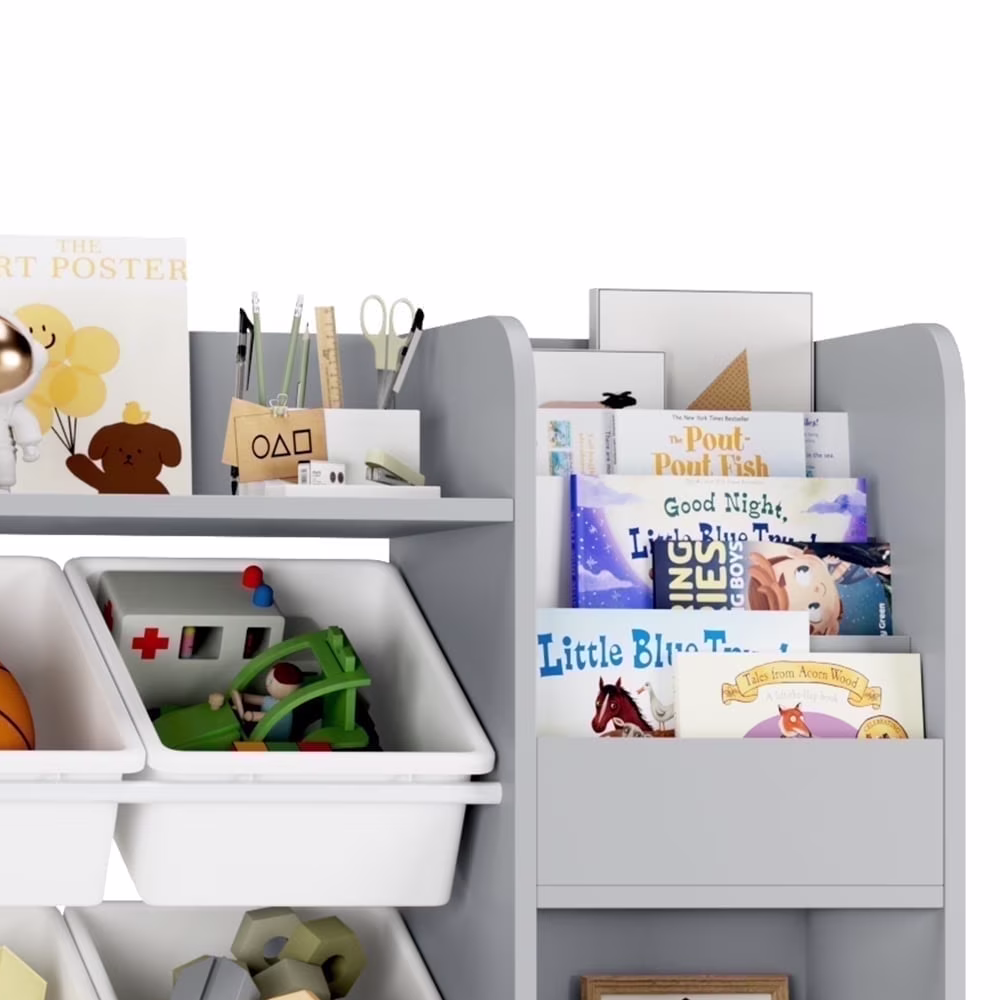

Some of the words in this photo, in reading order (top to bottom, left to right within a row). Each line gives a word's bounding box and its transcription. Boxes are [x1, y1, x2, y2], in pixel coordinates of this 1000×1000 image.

[56, 239, 102, 254] THE
[50, 257, 189, 281] POSTER
[669, 435, 683, 445] The
[683, 425, 751, 452] Pout-
[651, 452, 712, 477] Pout
[718, 454, 770, 478] Fish
[664, 492, 716, 517] Good
[724, 492, 788, 523] Night,
[729, 541, 744, 589] BOYS
[878, 602, 887, 629] Green
[537, 632, 624, 678] Little
[632, 628, 699, 669] Blu
[742, 670, 770, 688] Tales
[771, 666, 794, 680] from
[798, 665, 828, 680] Acorn
[831, 667, 859, 689] Wood
